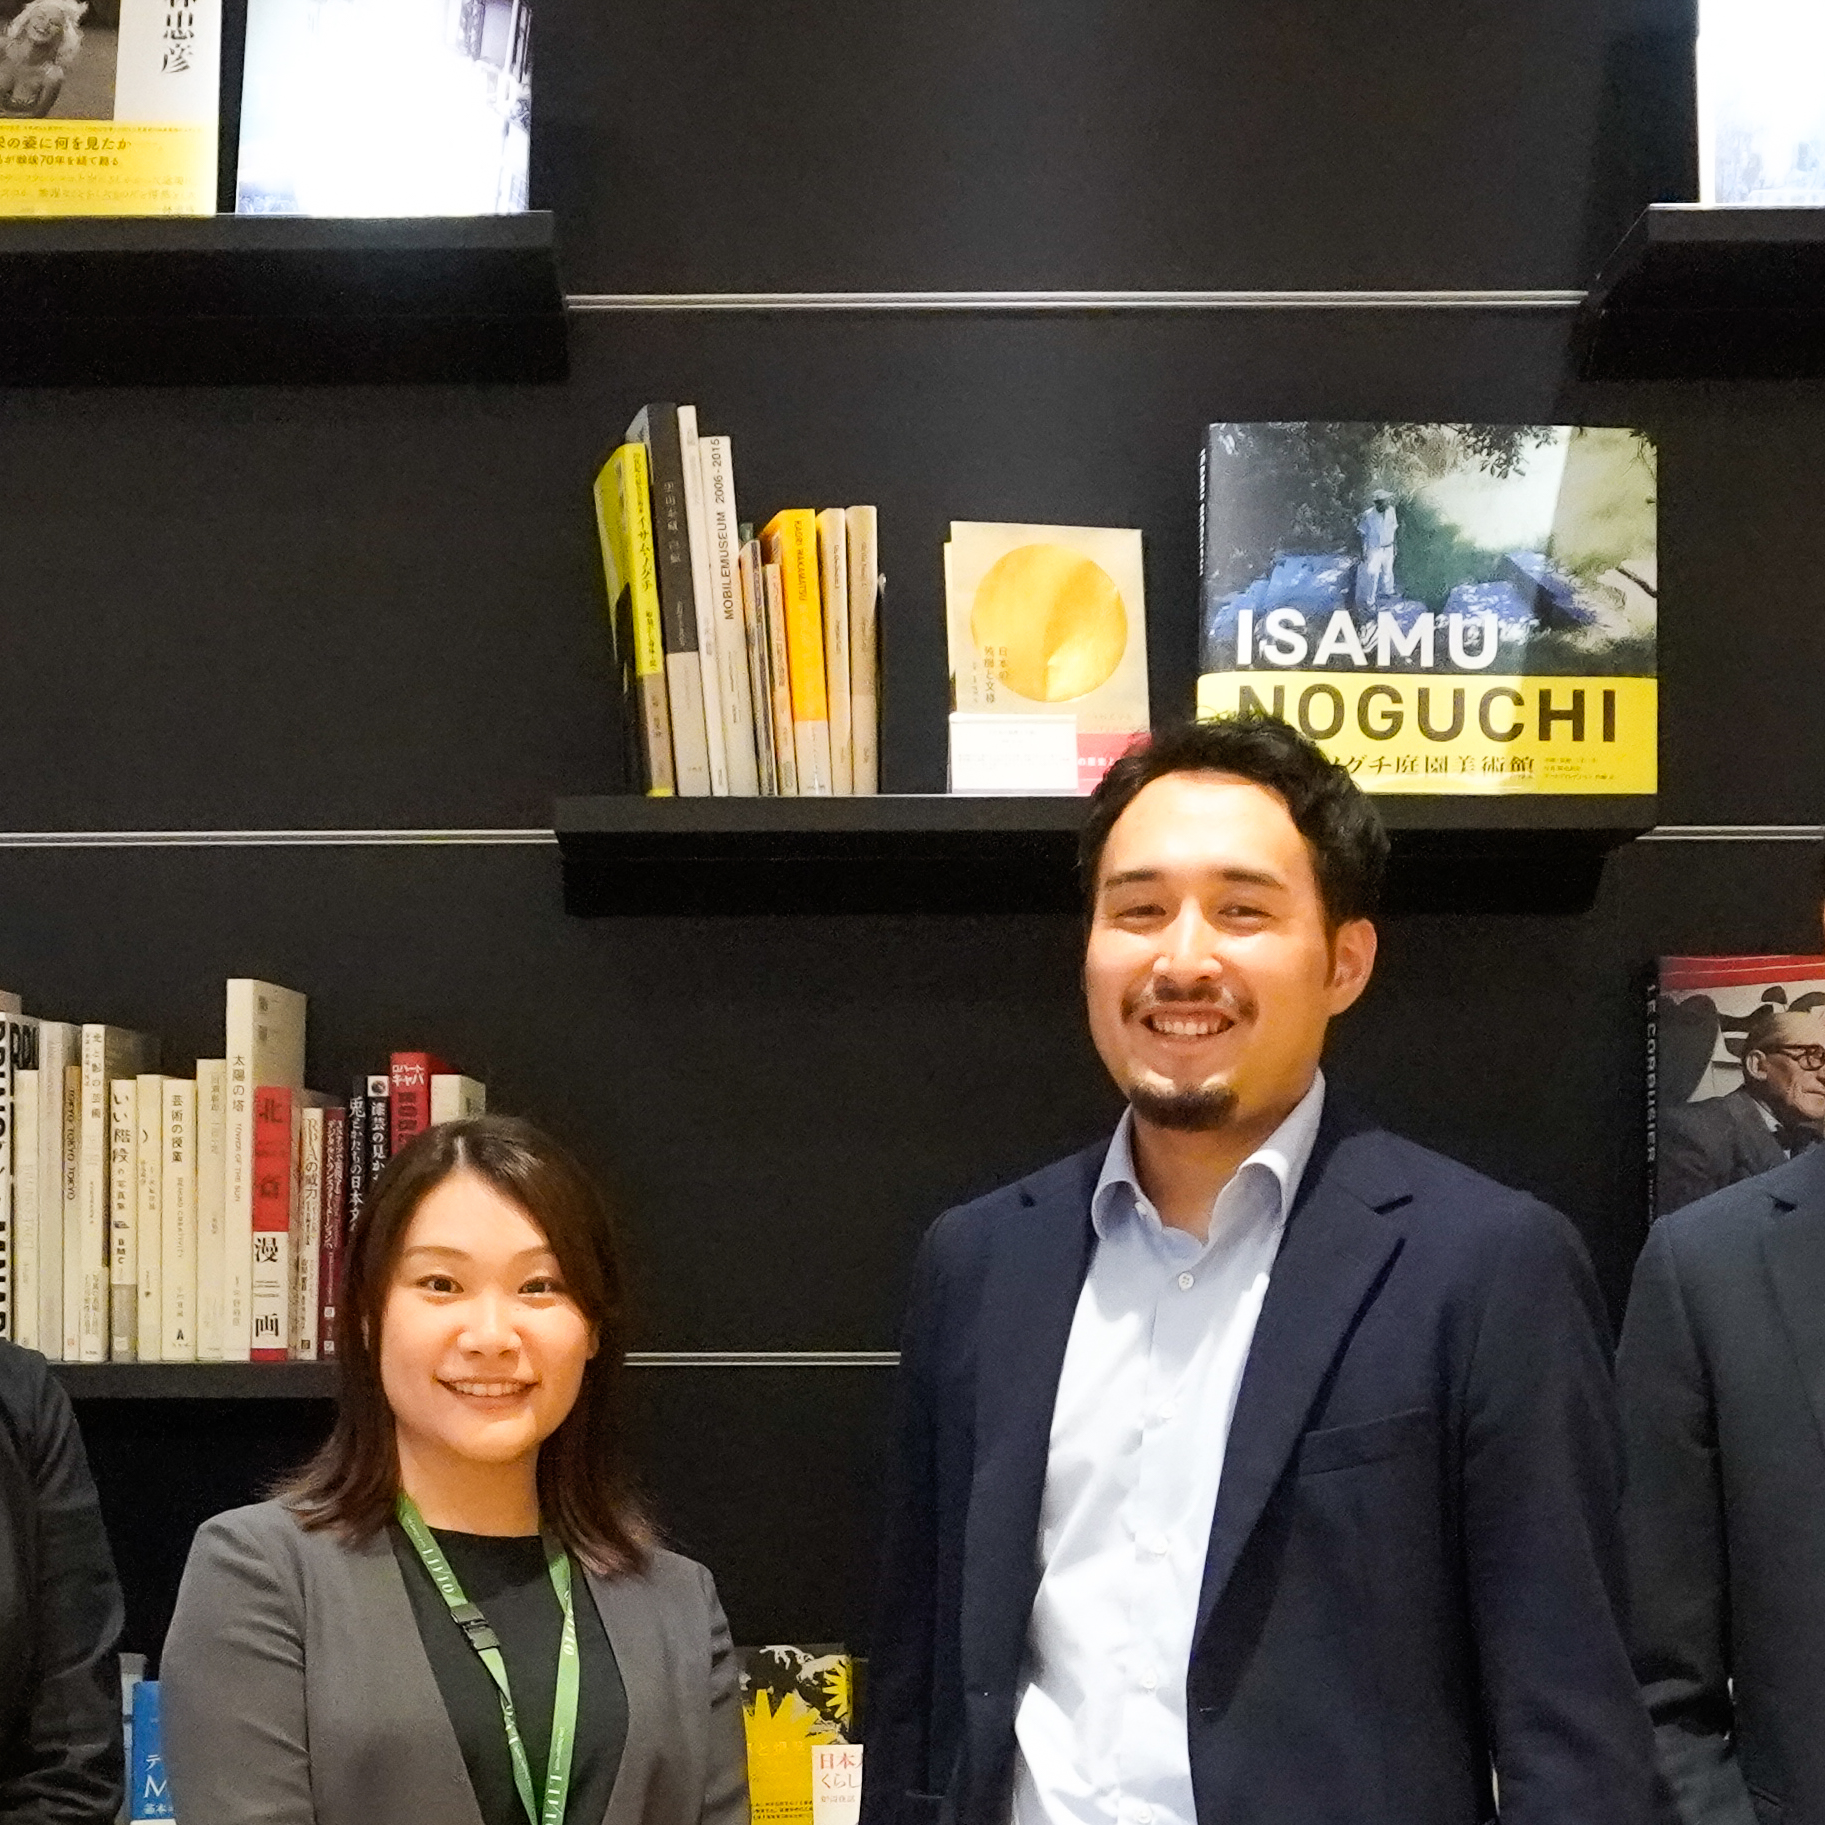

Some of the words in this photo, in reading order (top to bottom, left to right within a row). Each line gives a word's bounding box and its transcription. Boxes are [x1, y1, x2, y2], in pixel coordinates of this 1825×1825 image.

[162, 0, 196, 74] 忠彦
[715, 511, 735, 620] MOBILEMUSEUM
[1235, 608, 1499, 669] ISAMU
[1237, 684, 1617, 743] NOGUCHI
[392, 1074, 425, 1087] キャパ
[1646, 1022, 1657, 1163] CORBUSIER
[421, 1548, 456, 1594] LIVIO
[821, 1773, 861, 1789] くらし
